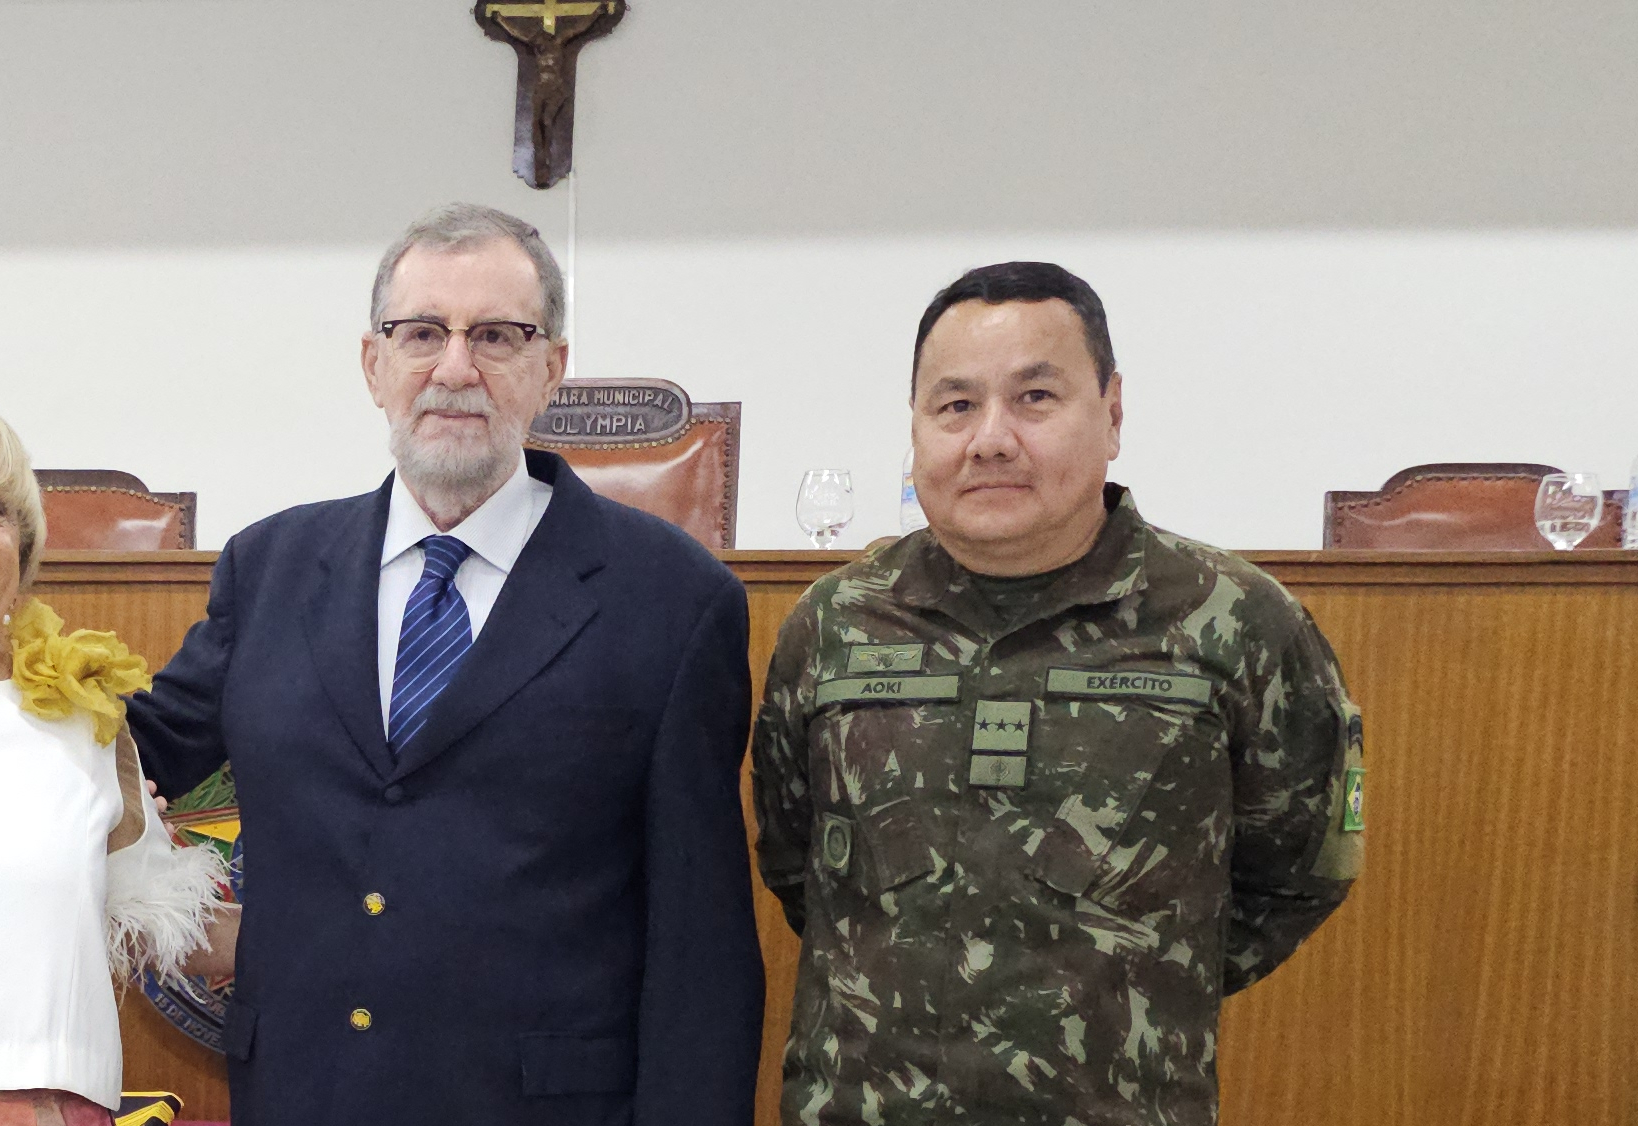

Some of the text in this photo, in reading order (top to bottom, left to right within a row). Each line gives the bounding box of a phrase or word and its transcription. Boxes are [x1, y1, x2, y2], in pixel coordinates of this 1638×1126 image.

[550, 390, 675, 411] MARA MUNICIPAL
[552, 414, 645, 433] OLYMPIA
[860, 681, 902, 694] AOKI
[1087, 674, 1173, 692] EXÉRCITO
[166, 1004, 186, 1022] DE
[184, 1018, 222, 1044] NOVE
